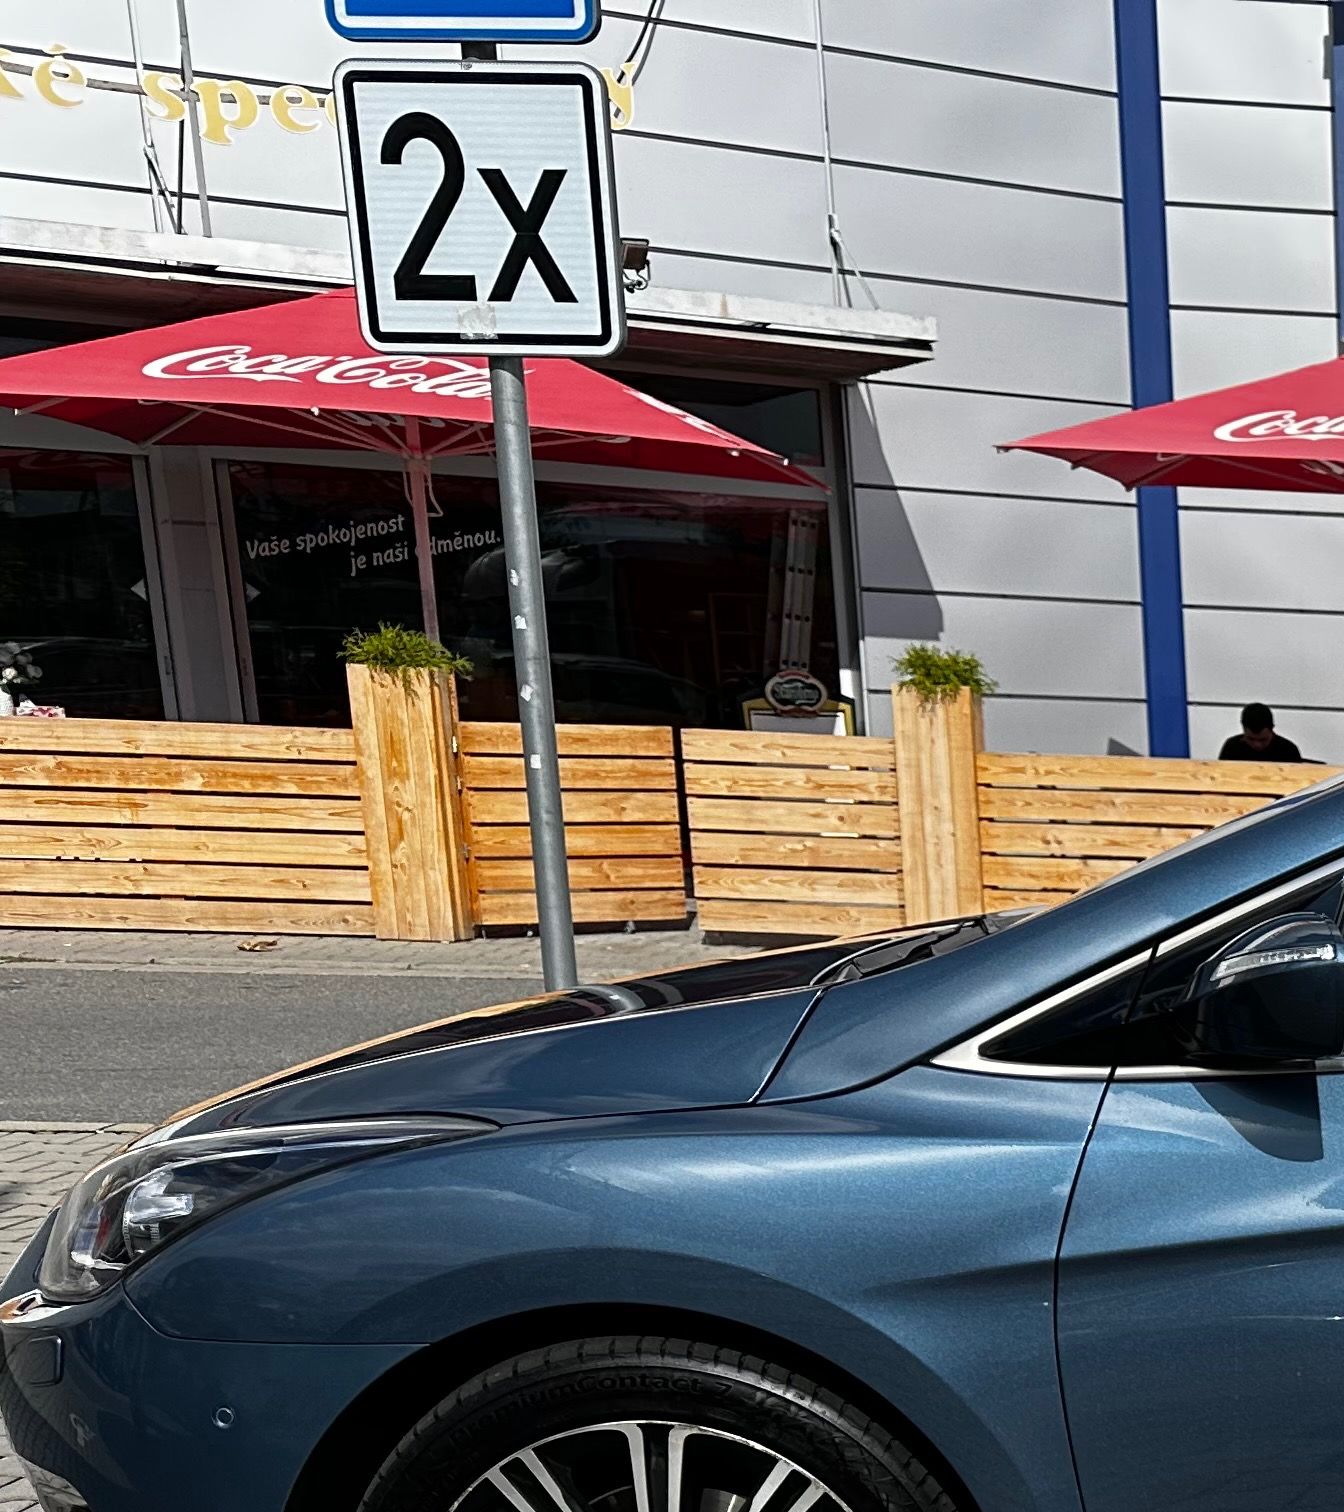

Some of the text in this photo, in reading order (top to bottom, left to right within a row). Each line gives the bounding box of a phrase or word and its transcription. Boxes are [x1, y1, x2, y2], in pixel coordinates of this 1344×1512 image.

[381, 112, 579, 303] 2x
[246, 513, 405, 559] Vaše spokojenost
[350, 553, 367, 577] je
[373, 541, 409, 567] naši
